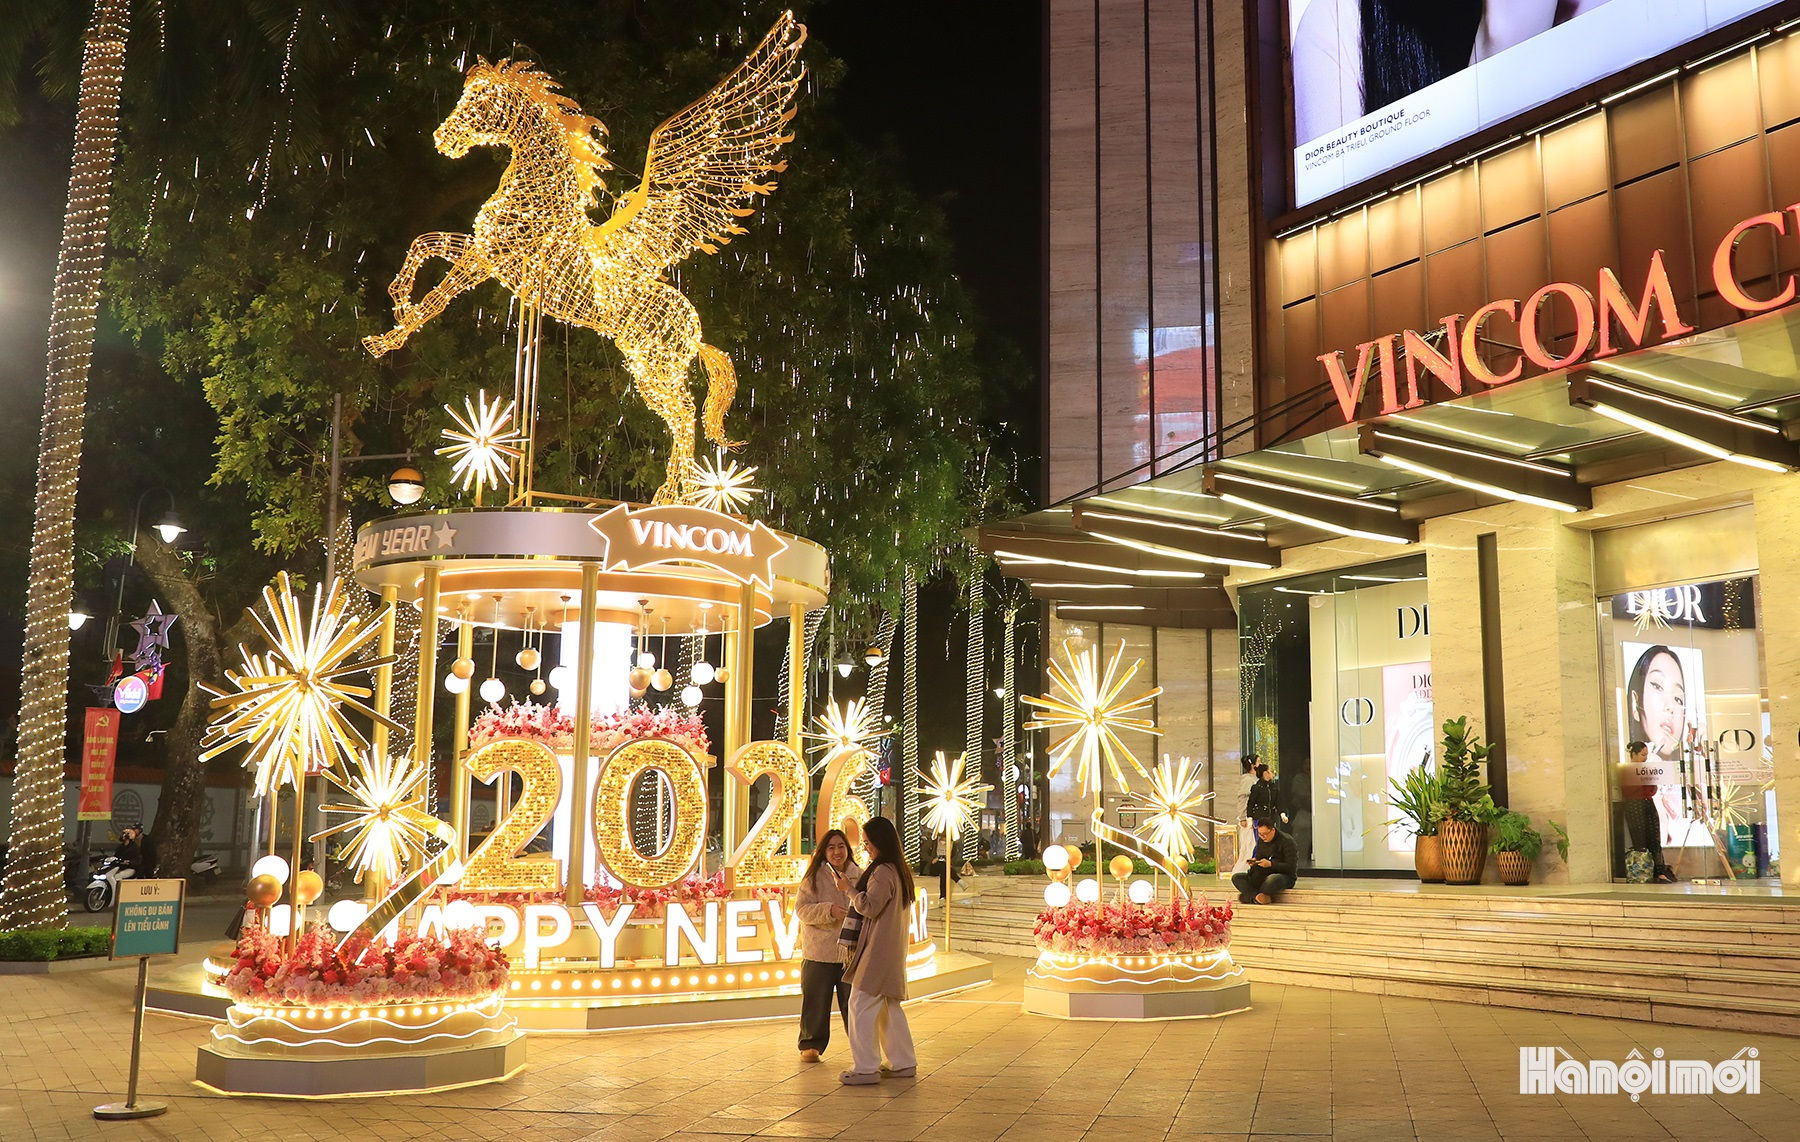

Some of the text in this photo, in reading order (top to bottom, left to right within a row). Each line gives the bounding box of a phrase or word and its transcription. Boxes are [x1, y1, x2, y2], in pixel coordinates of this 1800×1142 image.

[1305, 109, 1405, 161] DIOR BEAUTY BOUTIQUE
[1305, 153, 1334, 171] VINCOM
[1335, 148, 1345, 158] BA
[1369, 122, 1403, 143] GROUND
[1404, 109, 1431, 126] FLOOR
[1316, 248, 1695, 423] VINCOM
[381, 525, 433, 556] YEAR
[629, 518, 756, 558] VINCOM
[1396, 604, 1430, 639] DI
[1626, 585, 1707, 623] DIOR
[459, 738, 873, 892] 2026
[124, 916, 169, 932] LÊN TIỂU CẢNH
[125, 904, 147, 917] KHÔNG
